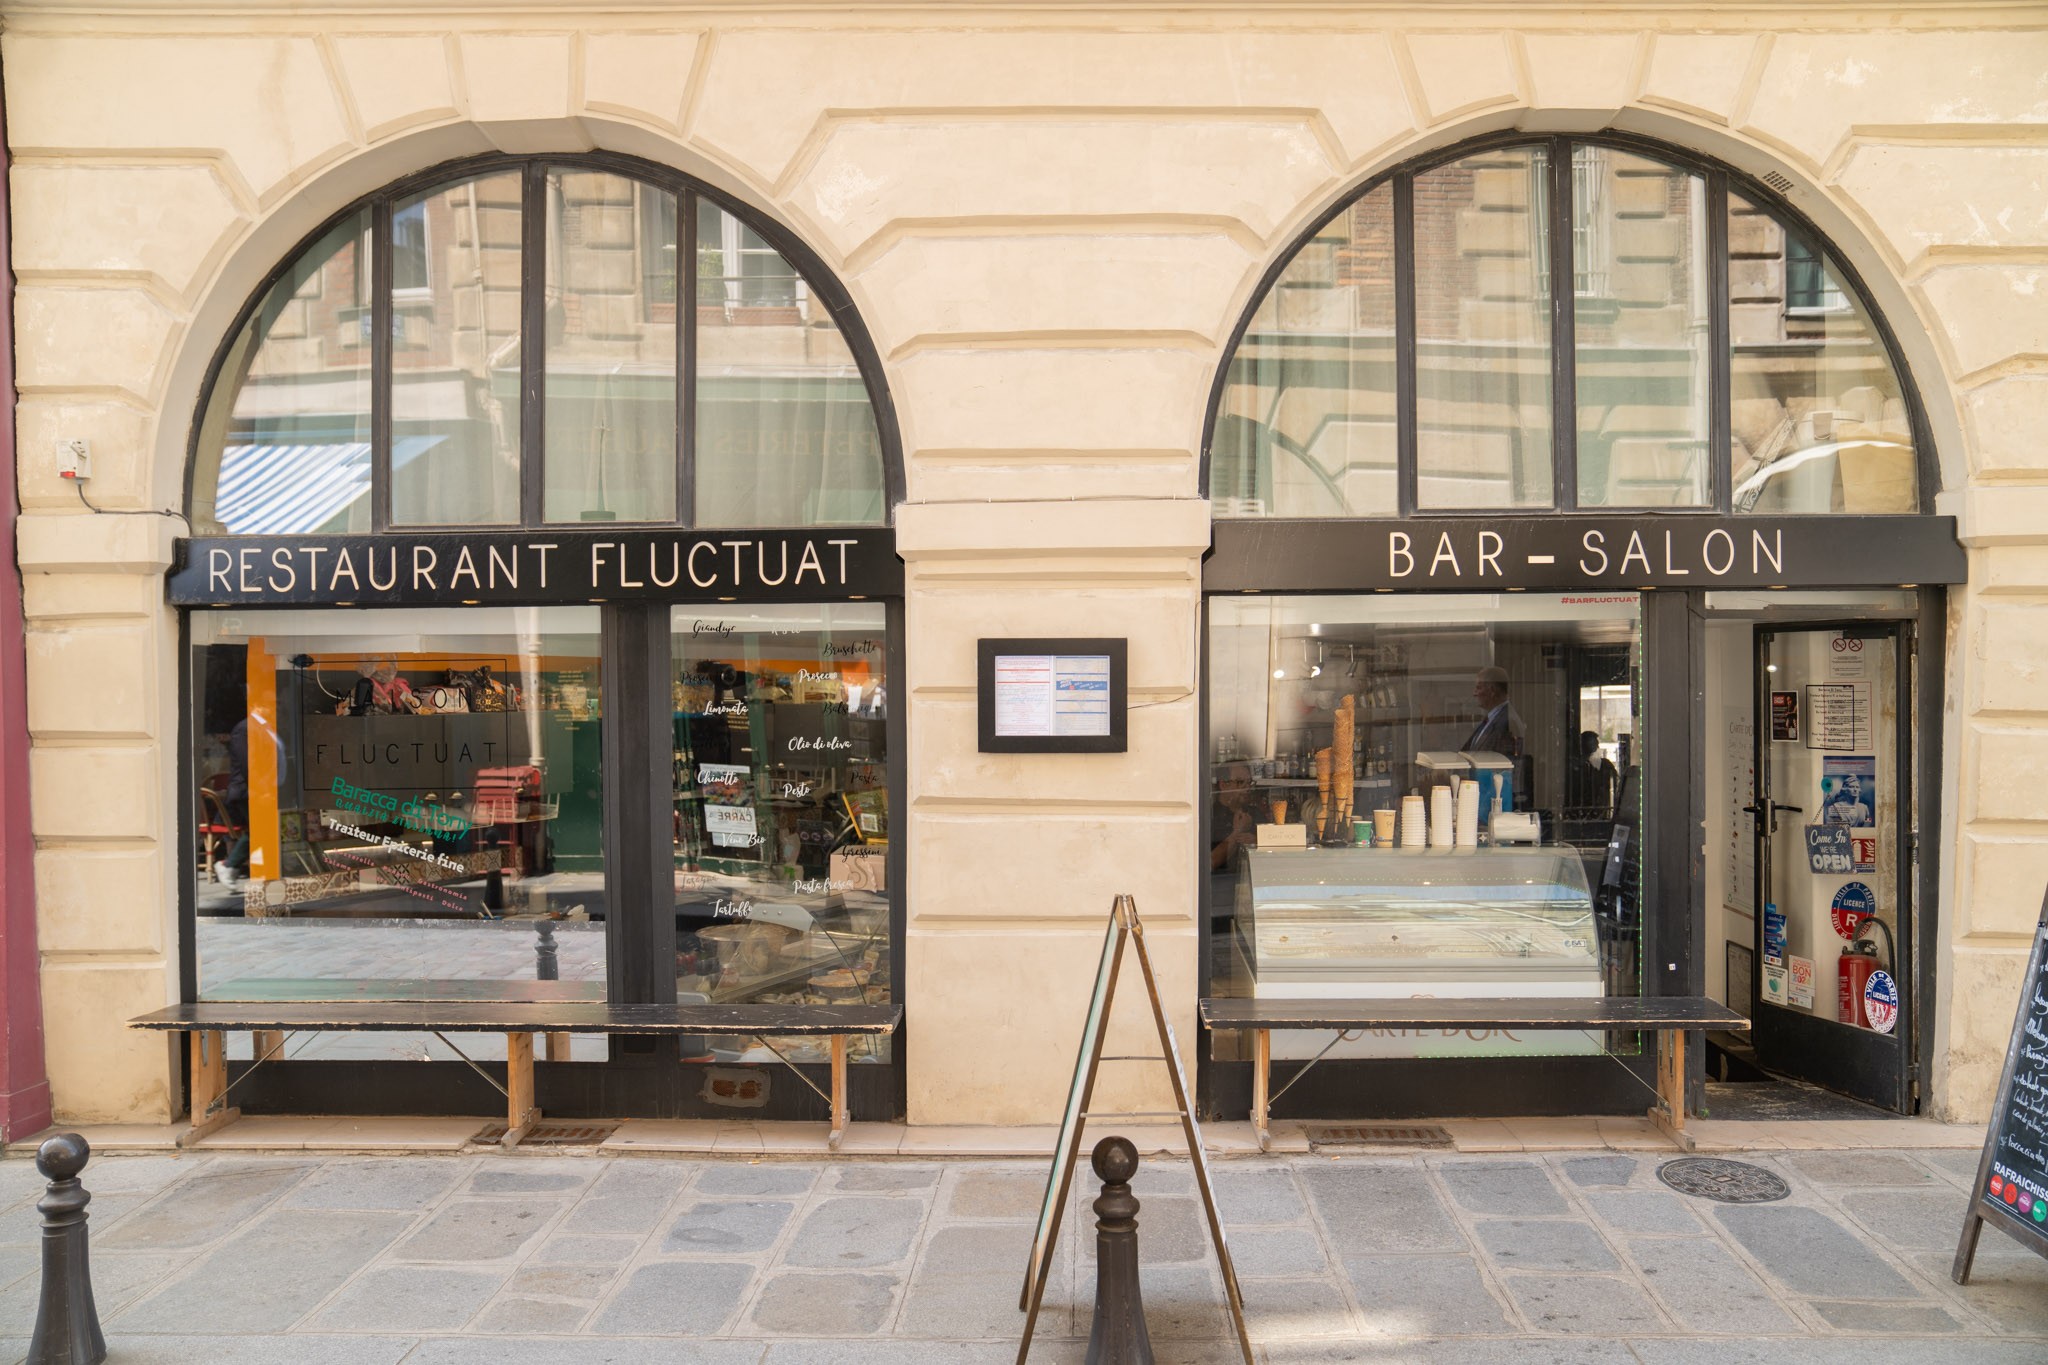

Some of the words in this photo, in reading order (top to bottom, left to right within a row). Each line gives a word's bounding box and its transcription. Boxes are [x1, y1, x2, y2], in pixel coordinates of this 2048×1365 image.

[1389, 530, 1503, 577] BAR
[1579, 528, 1782, 577] SALON
[208, 543, 558, 593] RESTAURANT
[592, 539, 859, 588] FLUCTUAT
[1561, 596, 1640, 604] #BARFLUCTUAT
[336, 688, 472, 709] MAISON
[703, 700, 748, 716] Limonata
[788, 736, 811, 751] Olio
[813, 737, 826, 749] di
[827, 736, 852, 750] oliva
[316, 742, 497, 765] FLUCTUAT
[697, 770, 739, 786] Chinotto
[782, 782, 811, 798] Pesto
[331, 776, 398, 812] Baracca
[401, 794, 425, 819] di
[428, 803, 473, 841] Tony
[329, 818, 381, 844] Traiteur
[381, 836, 435, 863] Epicerie
[436, 853, 465, 873] fine
[747, 832, 766, 846] Bio
[1810, 829, 1832, 846] Come
[1835, 829, 1847, 844] In
[323, 856, 352, 871] Salame
[1812, 854, 1852, 871] OPEN
[417, 878, 467, 901] Gastronomia
[792, 878, 823, 894] Pasta
[1835, 886, 1849, 901] VILLE
[1863, 888, 1875, 906] PARIS
[1843, 899, 1865, 909] LICENCE
[1846, 913, 1857, 927] R
[1793, 965, 1811, 978] BON
[1866, 974, 1877, 992] VILLE
[1885, 977, 1896, 1001] PARIS
[1872, 991, 1890, 1003] LICENCE
